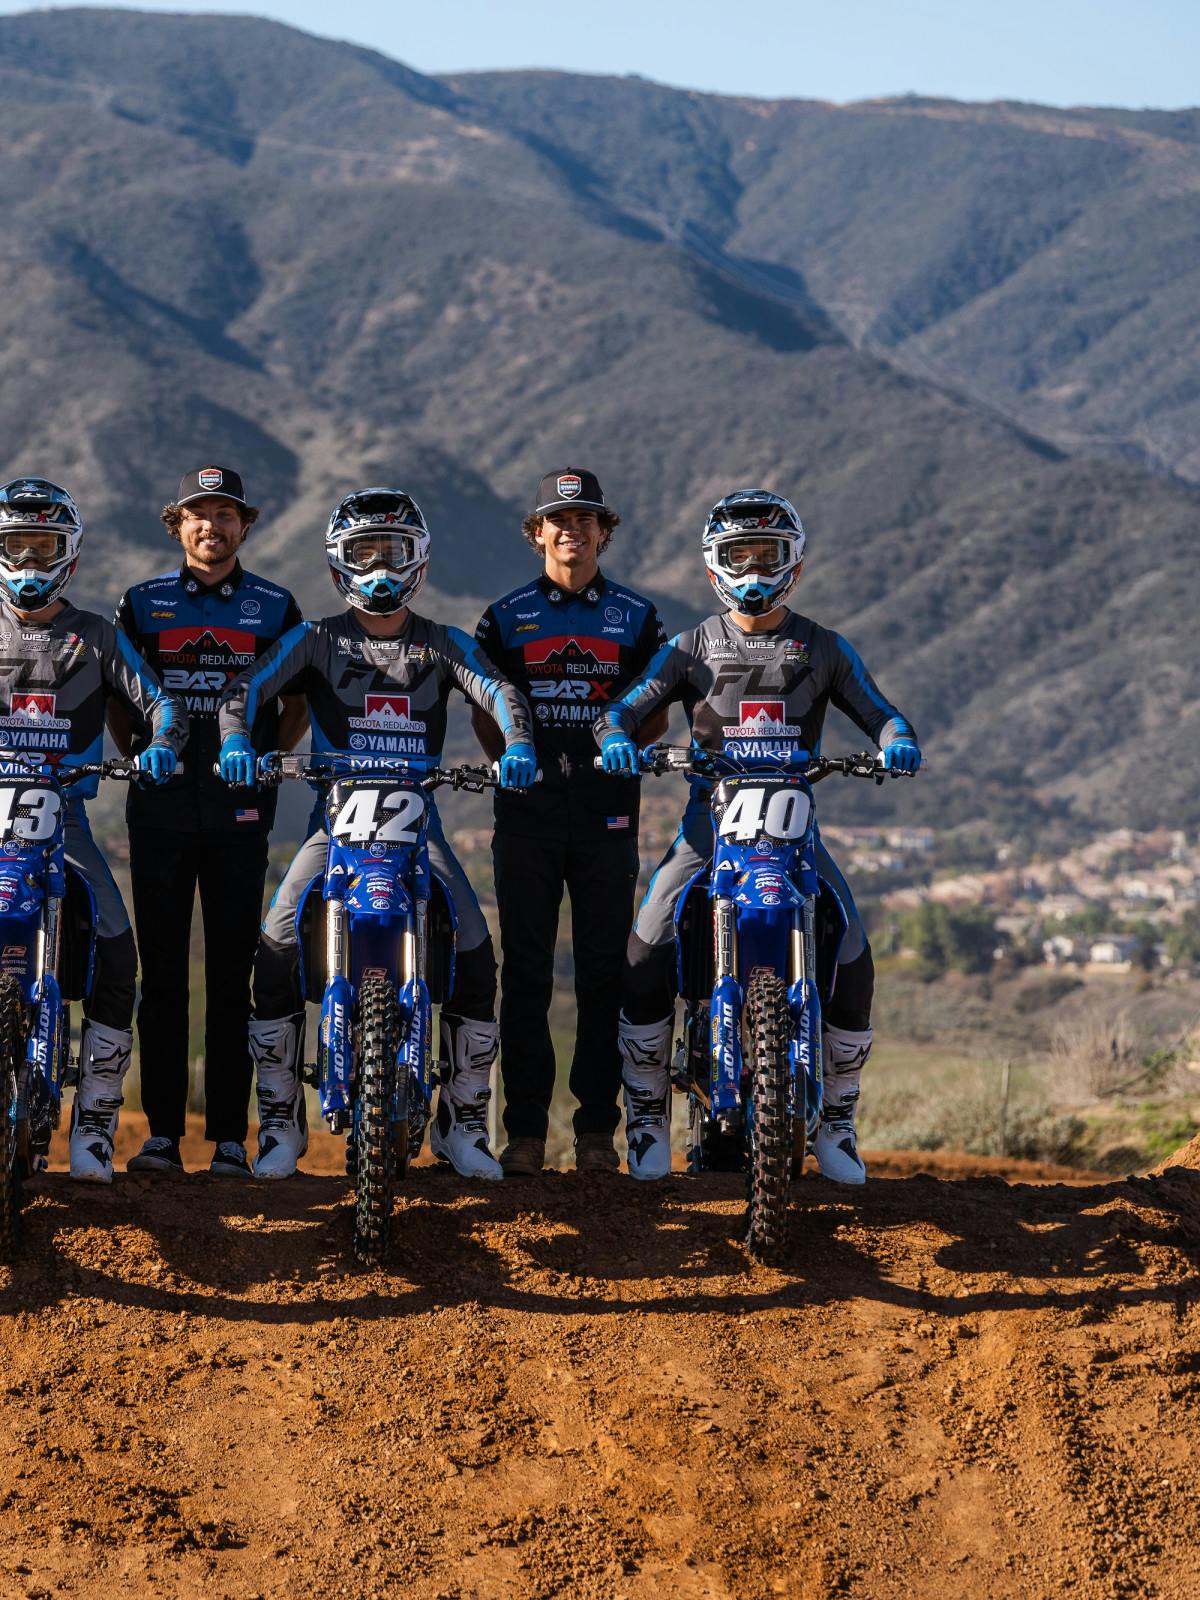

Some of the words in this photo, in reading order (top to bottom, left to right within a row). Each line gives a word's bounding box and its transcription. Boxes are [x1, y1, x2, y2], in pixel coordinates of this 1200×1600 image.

[21, 632, 51, 642] WPS
[370, 642, 400, 650] WPS
[745, 641, 776, 649] WPS
[160, 655, 197, 665] TOYOTA
[200, 654, 256, 665] REDLANDS
[526, 663, 564, 674] TOYOTA
[566, 664, 620, 675] REDLANDS
[337, 663, 438, 692] FLY
[711, 663, 815, 697] FLY
[528, 679, 614, 700] BARX
[185, 696, 223, 712] YAMA
[550, 704, 601, 721] YAMAH
[26, 718, 70, 729] REDLANDS
[350, 718, 381, 728] TOYOTA
[383, 720, 425, 731] REDLANDS
[724, 727, 757, 736] TOYOTA
[758, 727, 801, 736] REDLANDS
[11, 731, 68, 748] YAMAHA
[367, 735, 426, 754] YAMAHA
[743, 741, 799, 751] YAMAHA
[851, 766, 873, 774] ASV
[461, 782, 483, 790] ASV
[331, 789, 425, 844] 42
[718, 787, 811, 841] 40
